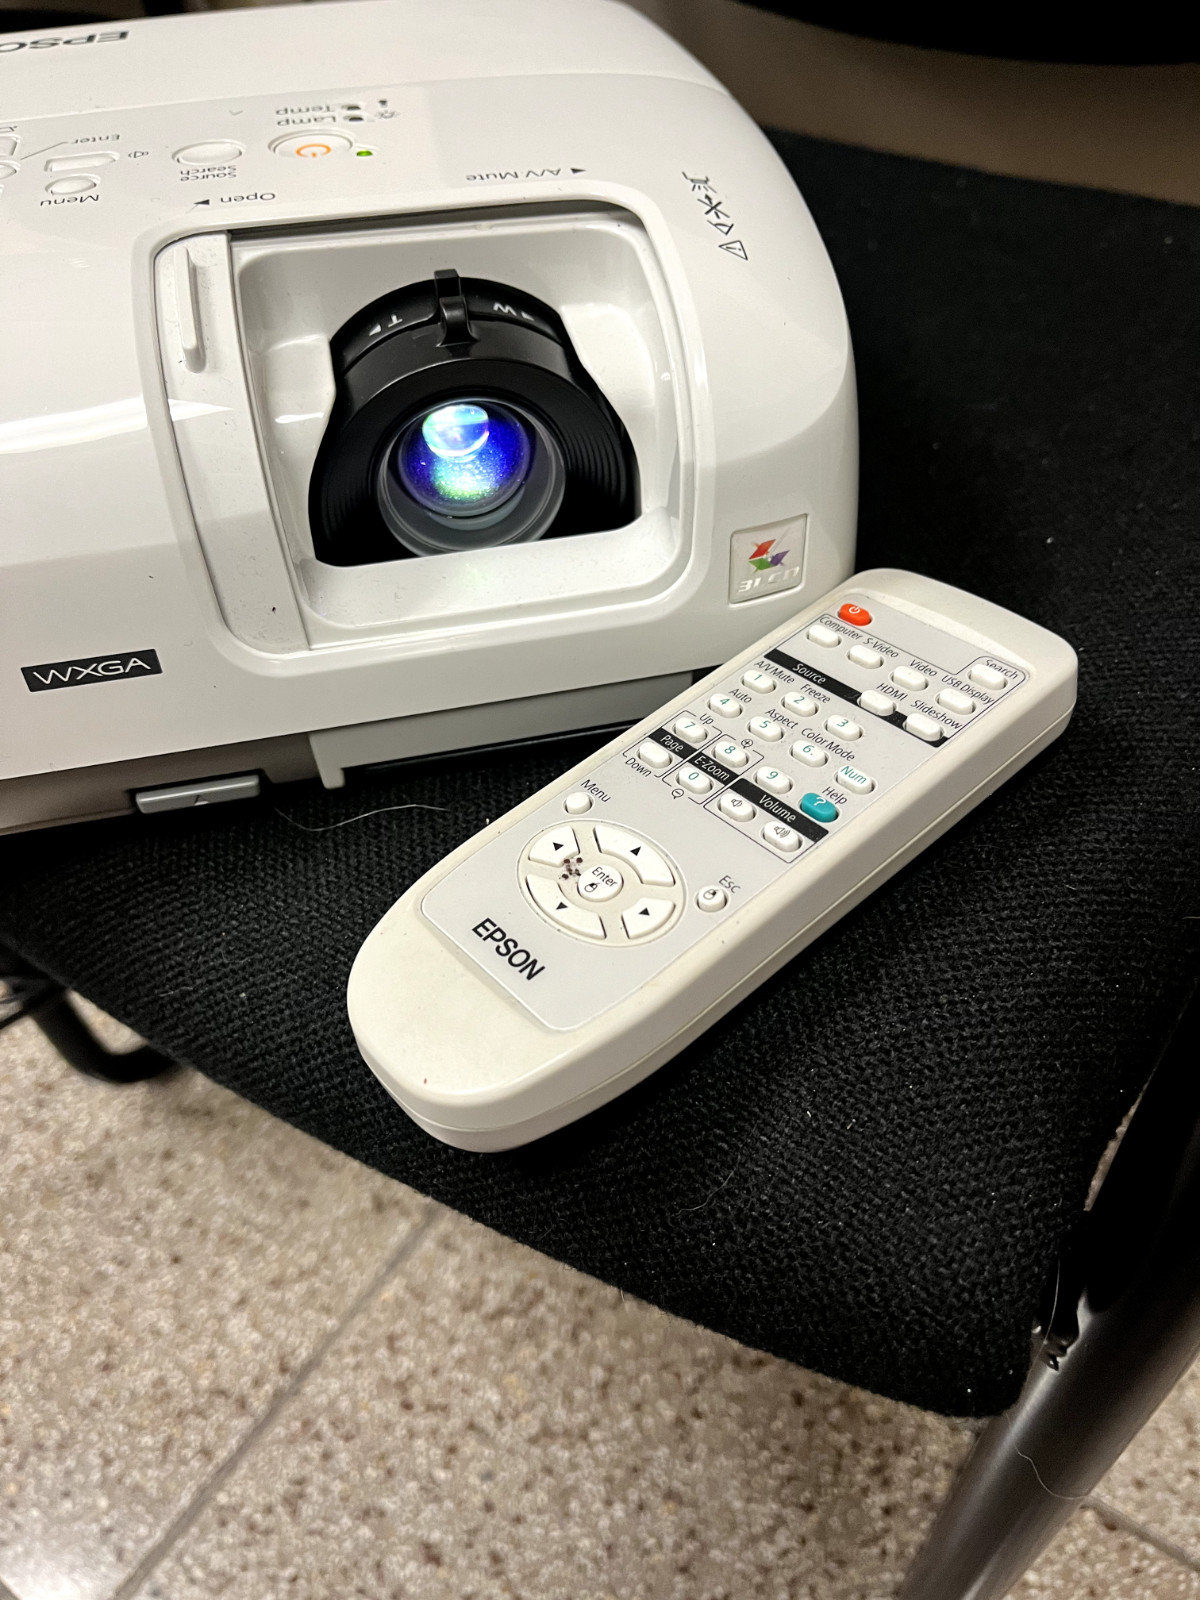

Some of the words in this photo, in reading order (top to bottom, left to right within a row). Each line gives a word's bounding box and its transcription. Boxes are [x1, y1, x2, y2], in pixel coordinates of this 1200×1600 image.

[275, 104, 336, 116] Temp
[276, 114, 337, 126] Lamp
[69, 133, 121, 145] Enter
[180, 164, 237, 175] Search
[180, 171, 238, 182] Source
[465, 171, 520, 181] Mute
[40, 194, 100, 207] Menu
[220, 192, 276, 204] Open
[387, 313, 404, 328] T
[818, 615, 864, 641] Computer
[862, 636, 900, 659] S-Video
[32, 656, 152, 685] WXGA
[753, 660, 775, 672] A/V
[769, 667, 796, 684] Mute
[753, 673, 763, 681] 1
[792, 663, 827, 684] Source
[909, 658, 938, 678] Video
[984, 658, 1019, 680] Search
[728, 687, 753, 704] Auto
[799, 683, 832, 704] Freeze
[874, 681, 909, 702] HDMI
[940, 674, 961, 689] USB
[960, 683, 995, 706] Display
[719, 697, 731, 706] 4
[793, 695, 806, 705] 2
[699, 713, 715, 726] Up
[764, 708, 800, 730] Aspect
[836, 718, 850, 728] 3
[910, 698, 964, 730] Slideshow
[683, 721, 696, 730] 7
[758, 719, 772, 729] 5
[659, 734, 684, 753] Page
[724, 745, 737, 755] 8
[800, 727, 828, 747] Color
[824, 740, 856, 761] Mode
[624, 756, 653, 778] Down
[687, 771, 700, 781] 0
[693, 755, 731, 781] E-Zoom
[766, 770, 779, 780] 9
[840, 765, 868, 785] Num
[580, 778, 612, 804] Menu
[821, 786, 849, 805] Help
[758, 794, 797, 823] Volume
[591, 865, 619, 888] Enter
[718, 875, 742, 895] Esc
[471, 917, 546, 981] EPSON
